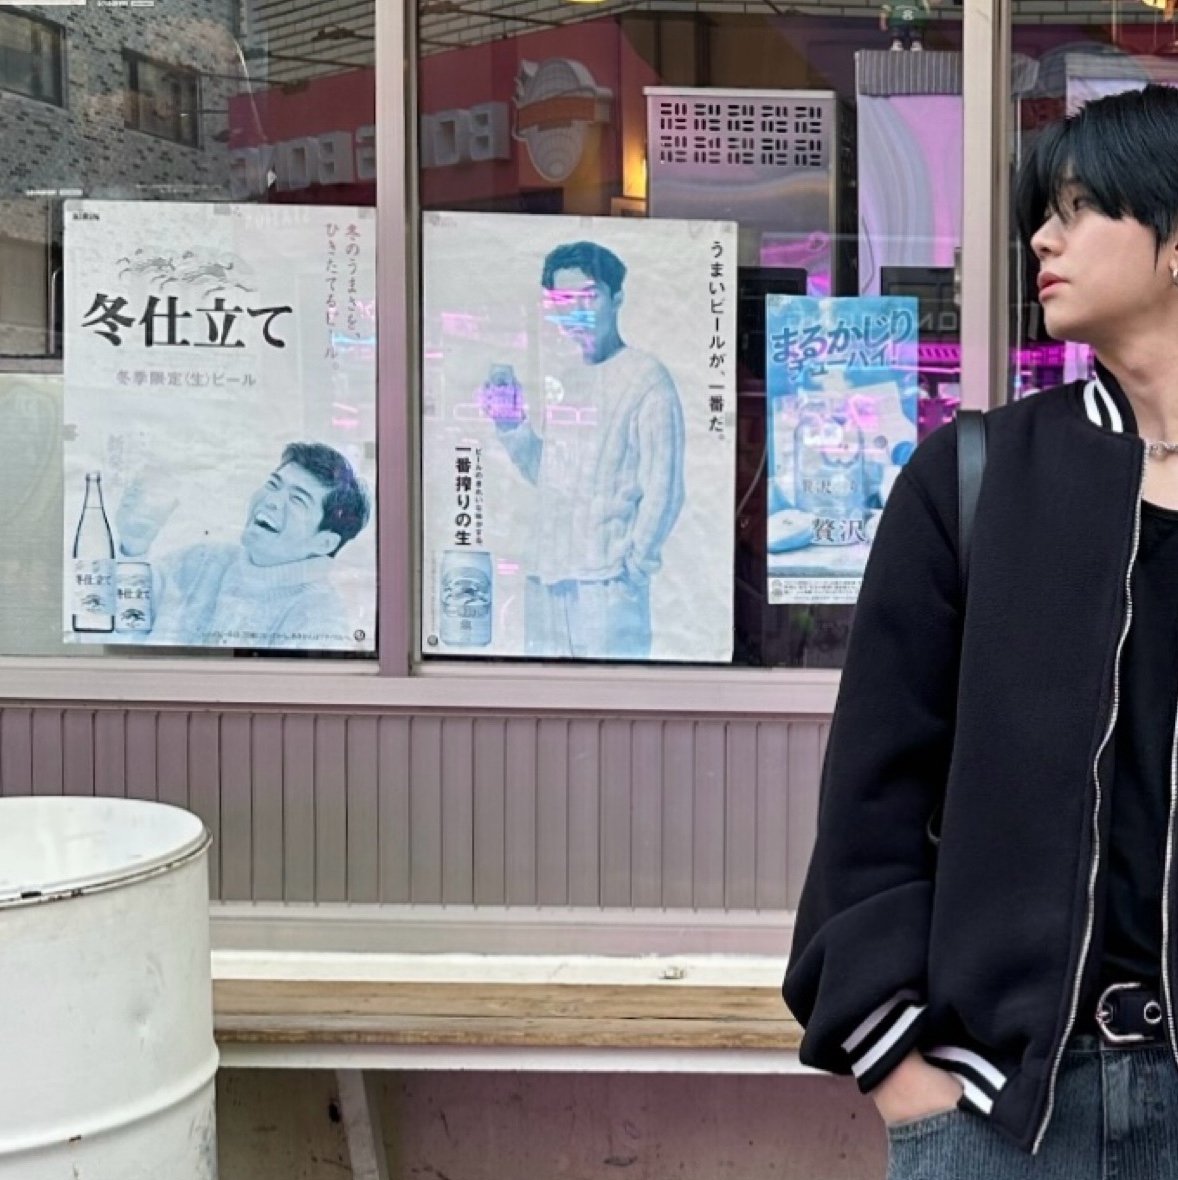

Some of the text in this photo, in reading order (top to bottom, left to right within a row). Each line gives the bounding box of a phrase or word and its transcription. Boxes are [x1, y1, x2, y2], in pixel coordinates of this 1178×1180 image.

[81, 292, 293, 348] 冬仕立て
[771, 309, 913, 364] まるかじり
[455, 446, 472, 546] 一番搾りの生
